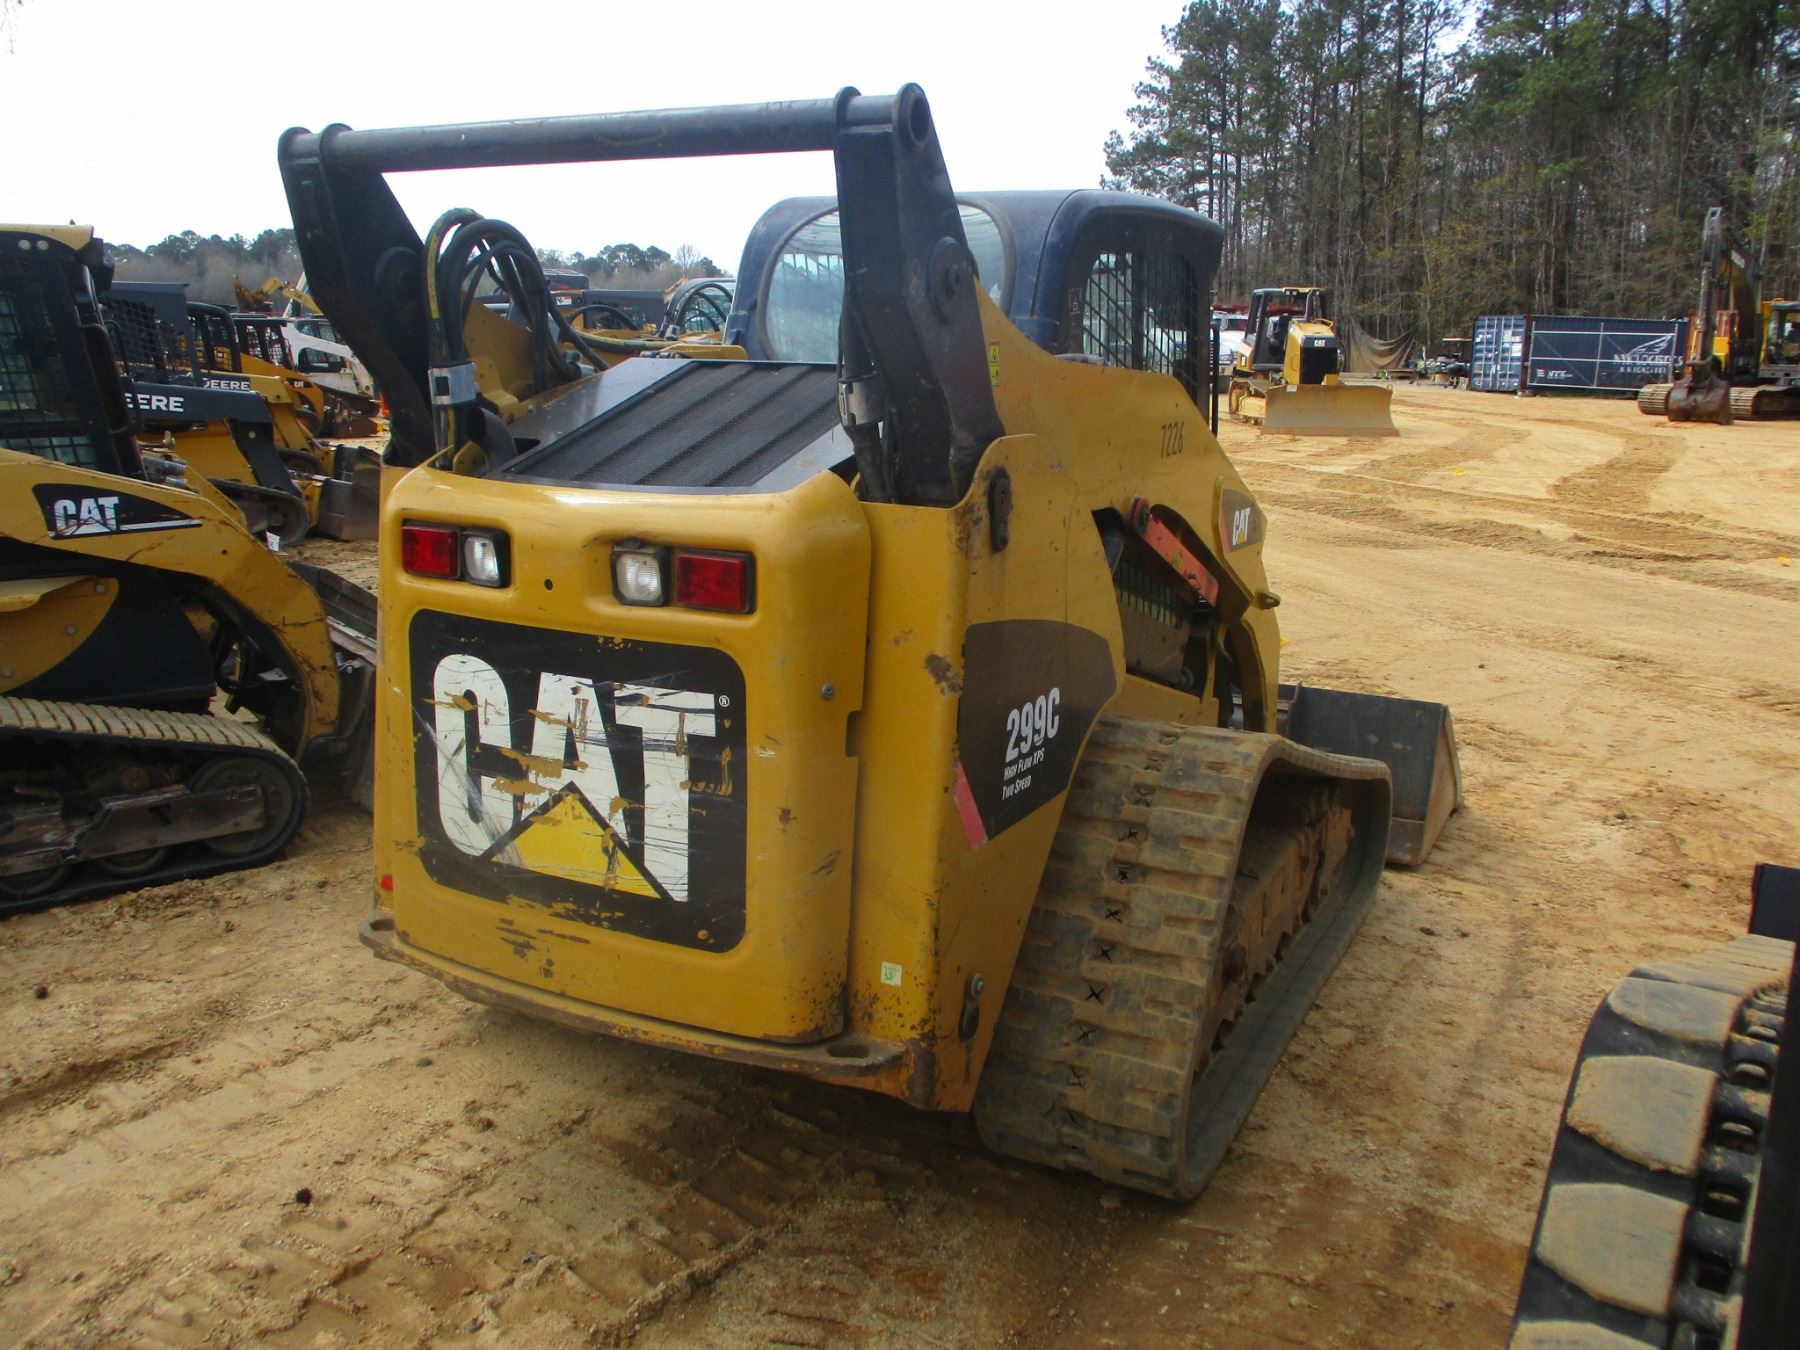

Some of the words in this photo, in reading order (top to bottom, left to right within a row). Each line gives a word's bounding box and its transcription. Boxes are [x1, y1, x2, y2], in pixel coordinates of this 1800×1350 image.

[1314, 339, 1326, 347] CAT
[1635, 354, 1684, 367] LOGISTCS
[124, 392, 185, 413] ERE
[1161, 421, 1185, 459] 7226
[53, 496, 120, 536] CAT
[1232, 507, 1251, 546] CAT
[1006, 688, 1060, 763] 299C
[433, 653, 716, 903] CAT
[1015, 775, 1032, 794] SPEED
